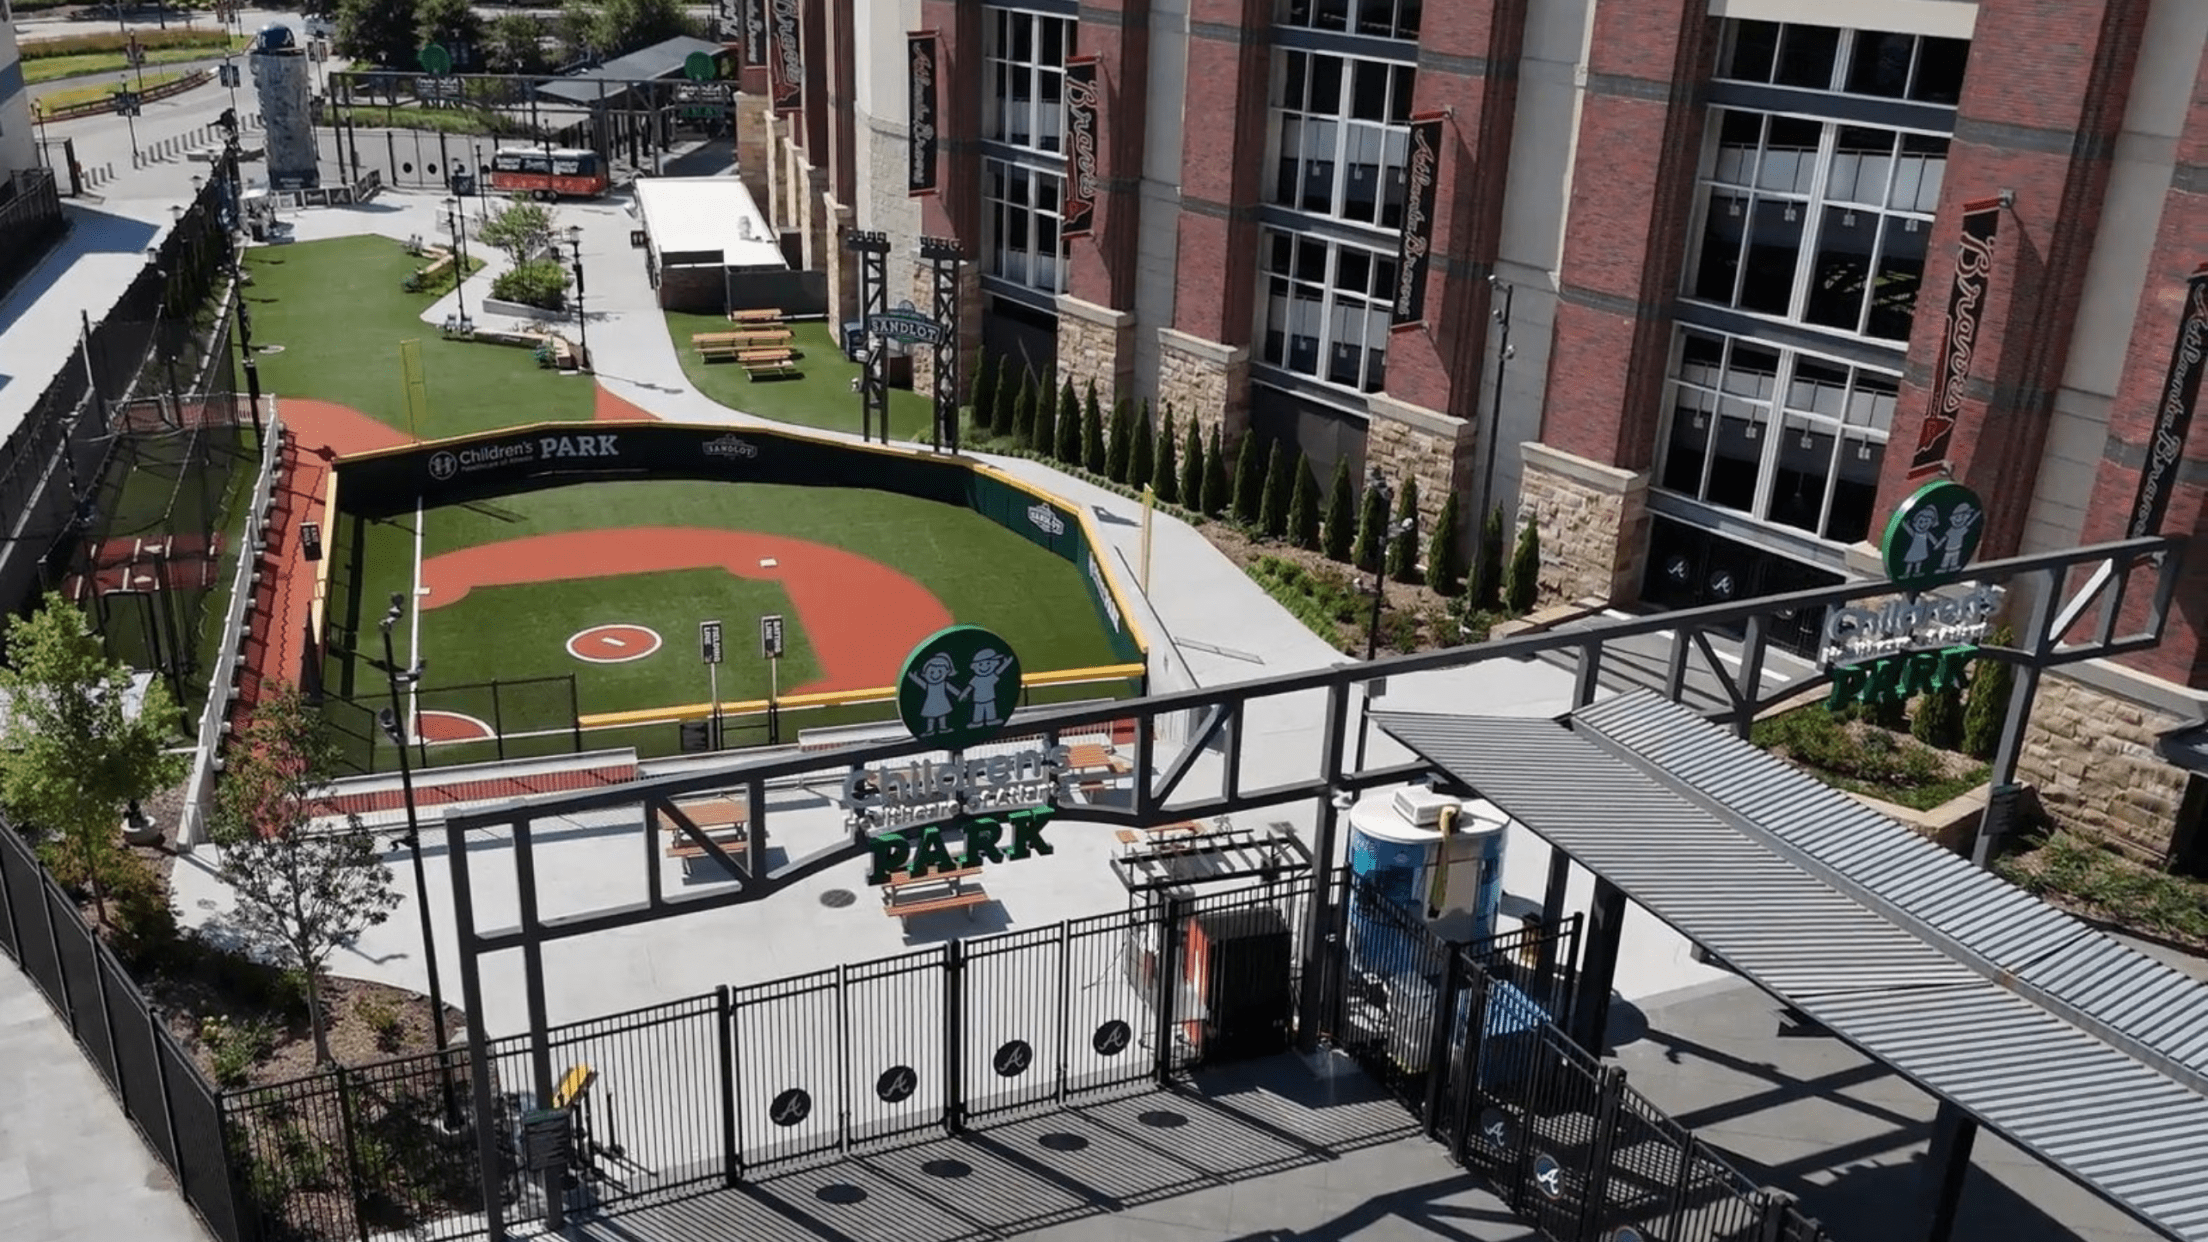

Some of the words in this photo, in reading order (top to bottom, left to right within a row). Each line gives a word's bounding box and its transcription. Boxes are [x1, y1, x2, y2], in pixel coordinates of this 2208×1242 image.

[913, 42, 932, 121] Atlanta
[913, 119, 934, 184] Braves
[1066, 76, 1099, 199] Braves
[1407, 128, 1435, 232] Atlanta
[1398, 229, 1427, 316] Braves
[871, 320, 938, 341] SANDLOT
[1943, 231, 1996, 413] Braves
[2160, 282, 2208, 429] Atlanta
[459, 441, 533, 465] Children's
[539, 435, 619, 460] PARK
[1828, 586, 2002, 640] Children's
[1824, 644, 1980, 711] PARK
[842, 737, 1071, 809] Children's
[866, 805, 1056, 887] PARK
